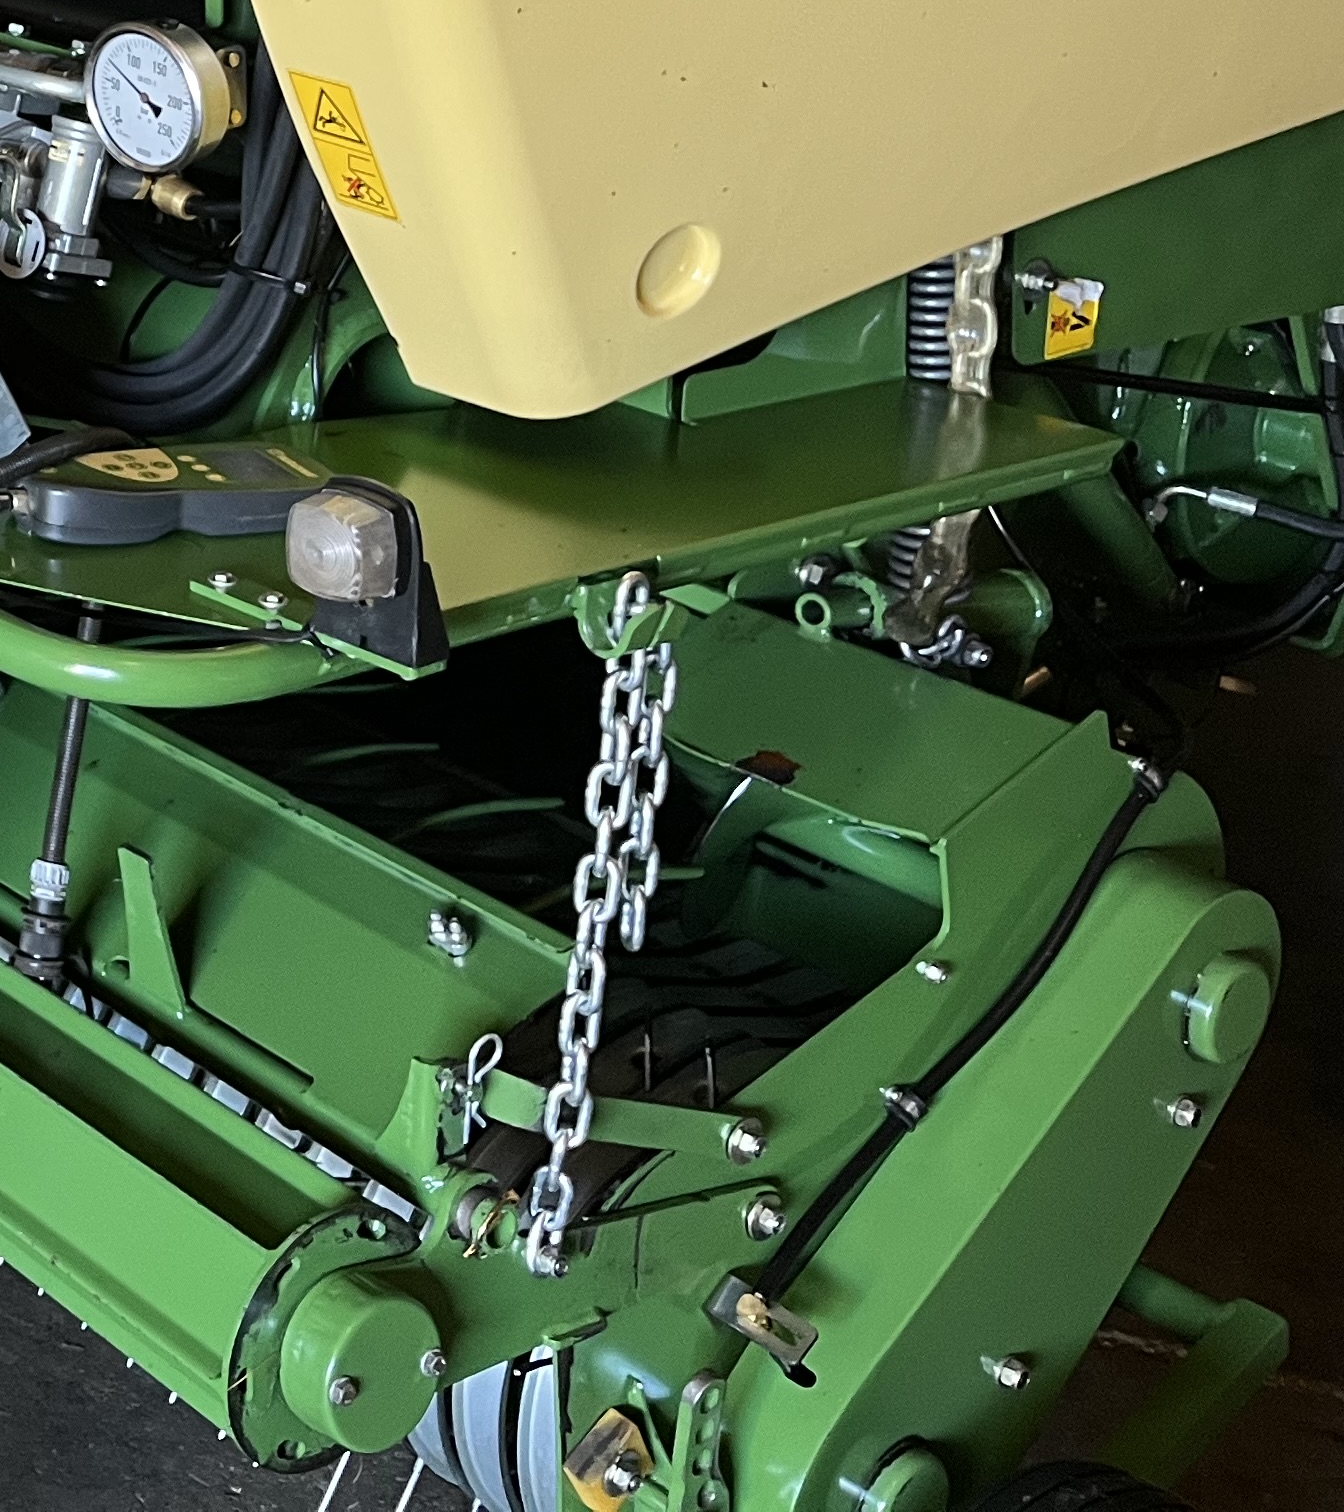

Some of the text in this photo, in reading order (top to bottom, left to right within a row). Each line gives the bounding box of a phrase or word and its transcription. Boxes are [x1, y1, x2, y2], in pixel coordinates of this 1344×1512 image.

[126, 52, 142, 70] 100
[152, 60, 168, 77] 150
[166, 94, 184, 111] 200
[157, 121, 173, 139] 250
